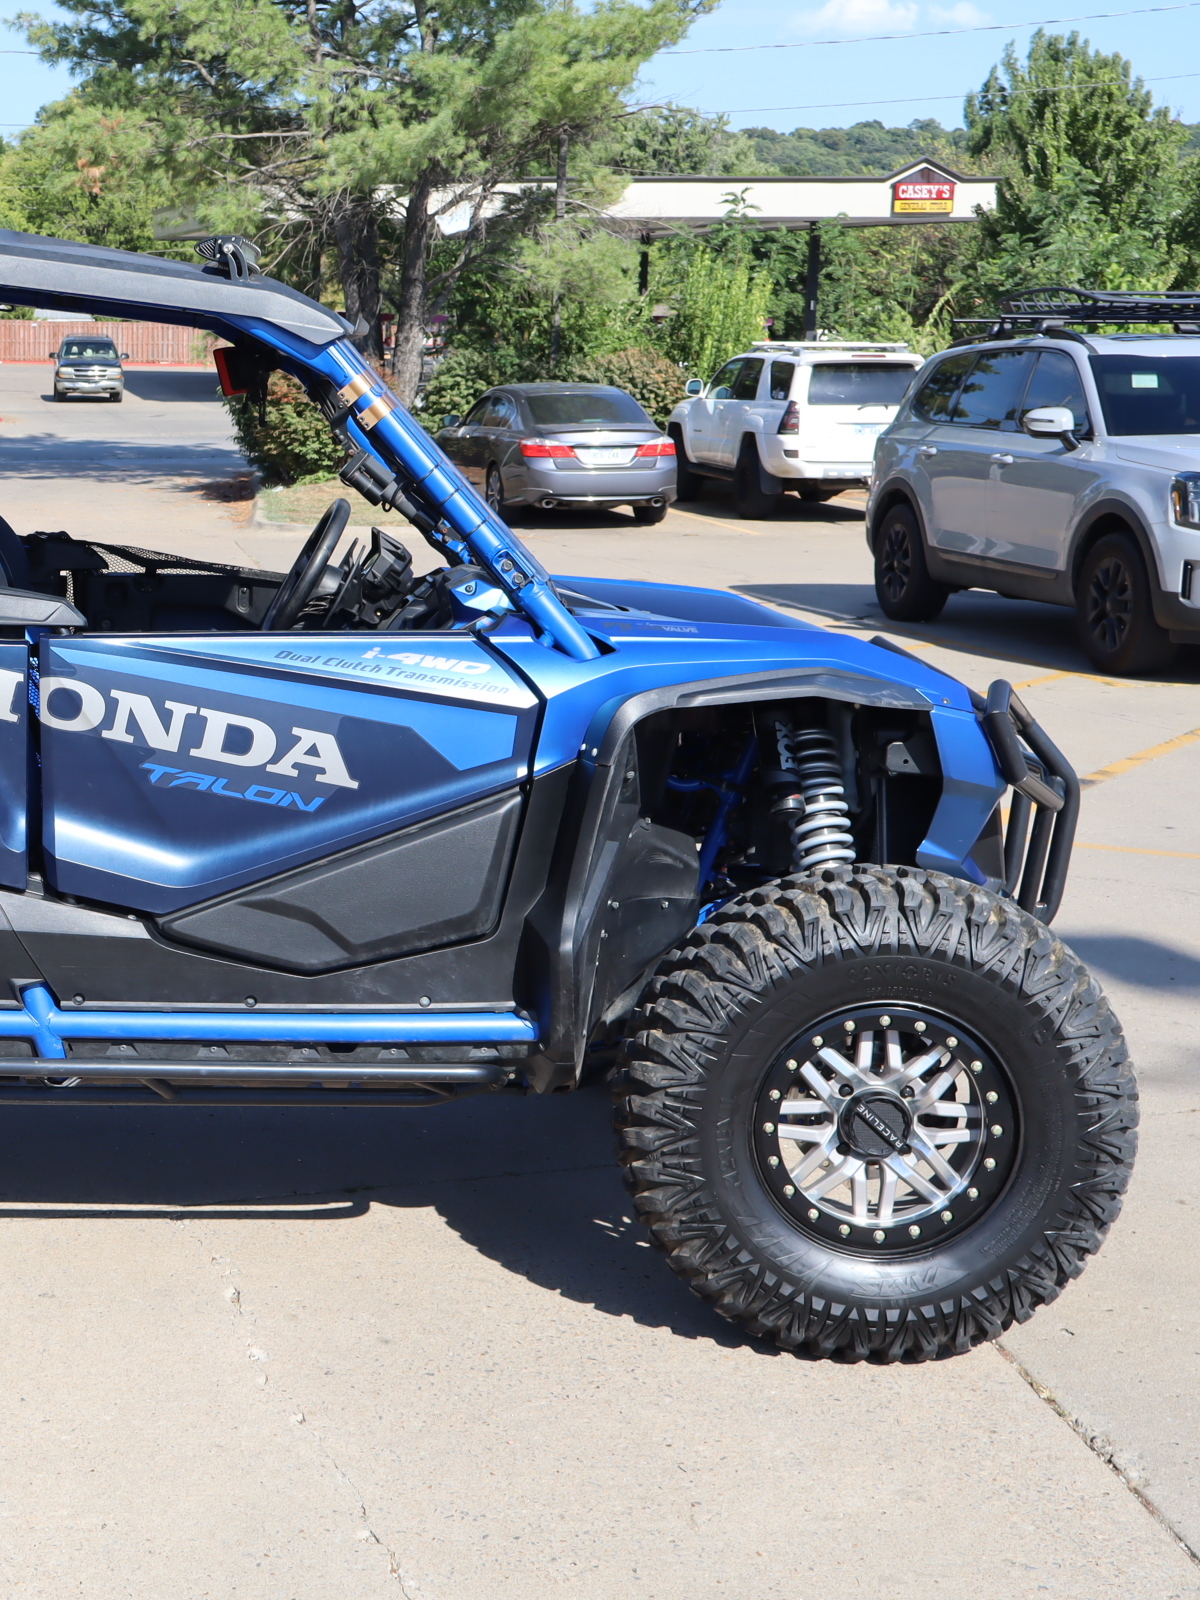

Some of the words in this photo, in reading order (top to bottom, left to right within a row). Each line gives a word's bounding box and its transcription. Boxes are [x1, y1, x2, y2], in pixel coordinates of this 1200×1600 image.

[898, 184, 951, 199] CASEY'S
[273, 650, 322, 664] Dual
[322, 657, 382, 674] Clutch
[386, 666, 510, 695] Transmission
[361, 646, 492, 675] i-4WD
[775, 721, 798, 770] FOX
[140, 763, 326, 813] TALON
[856, 1104, 904, 1148] RACELINE
